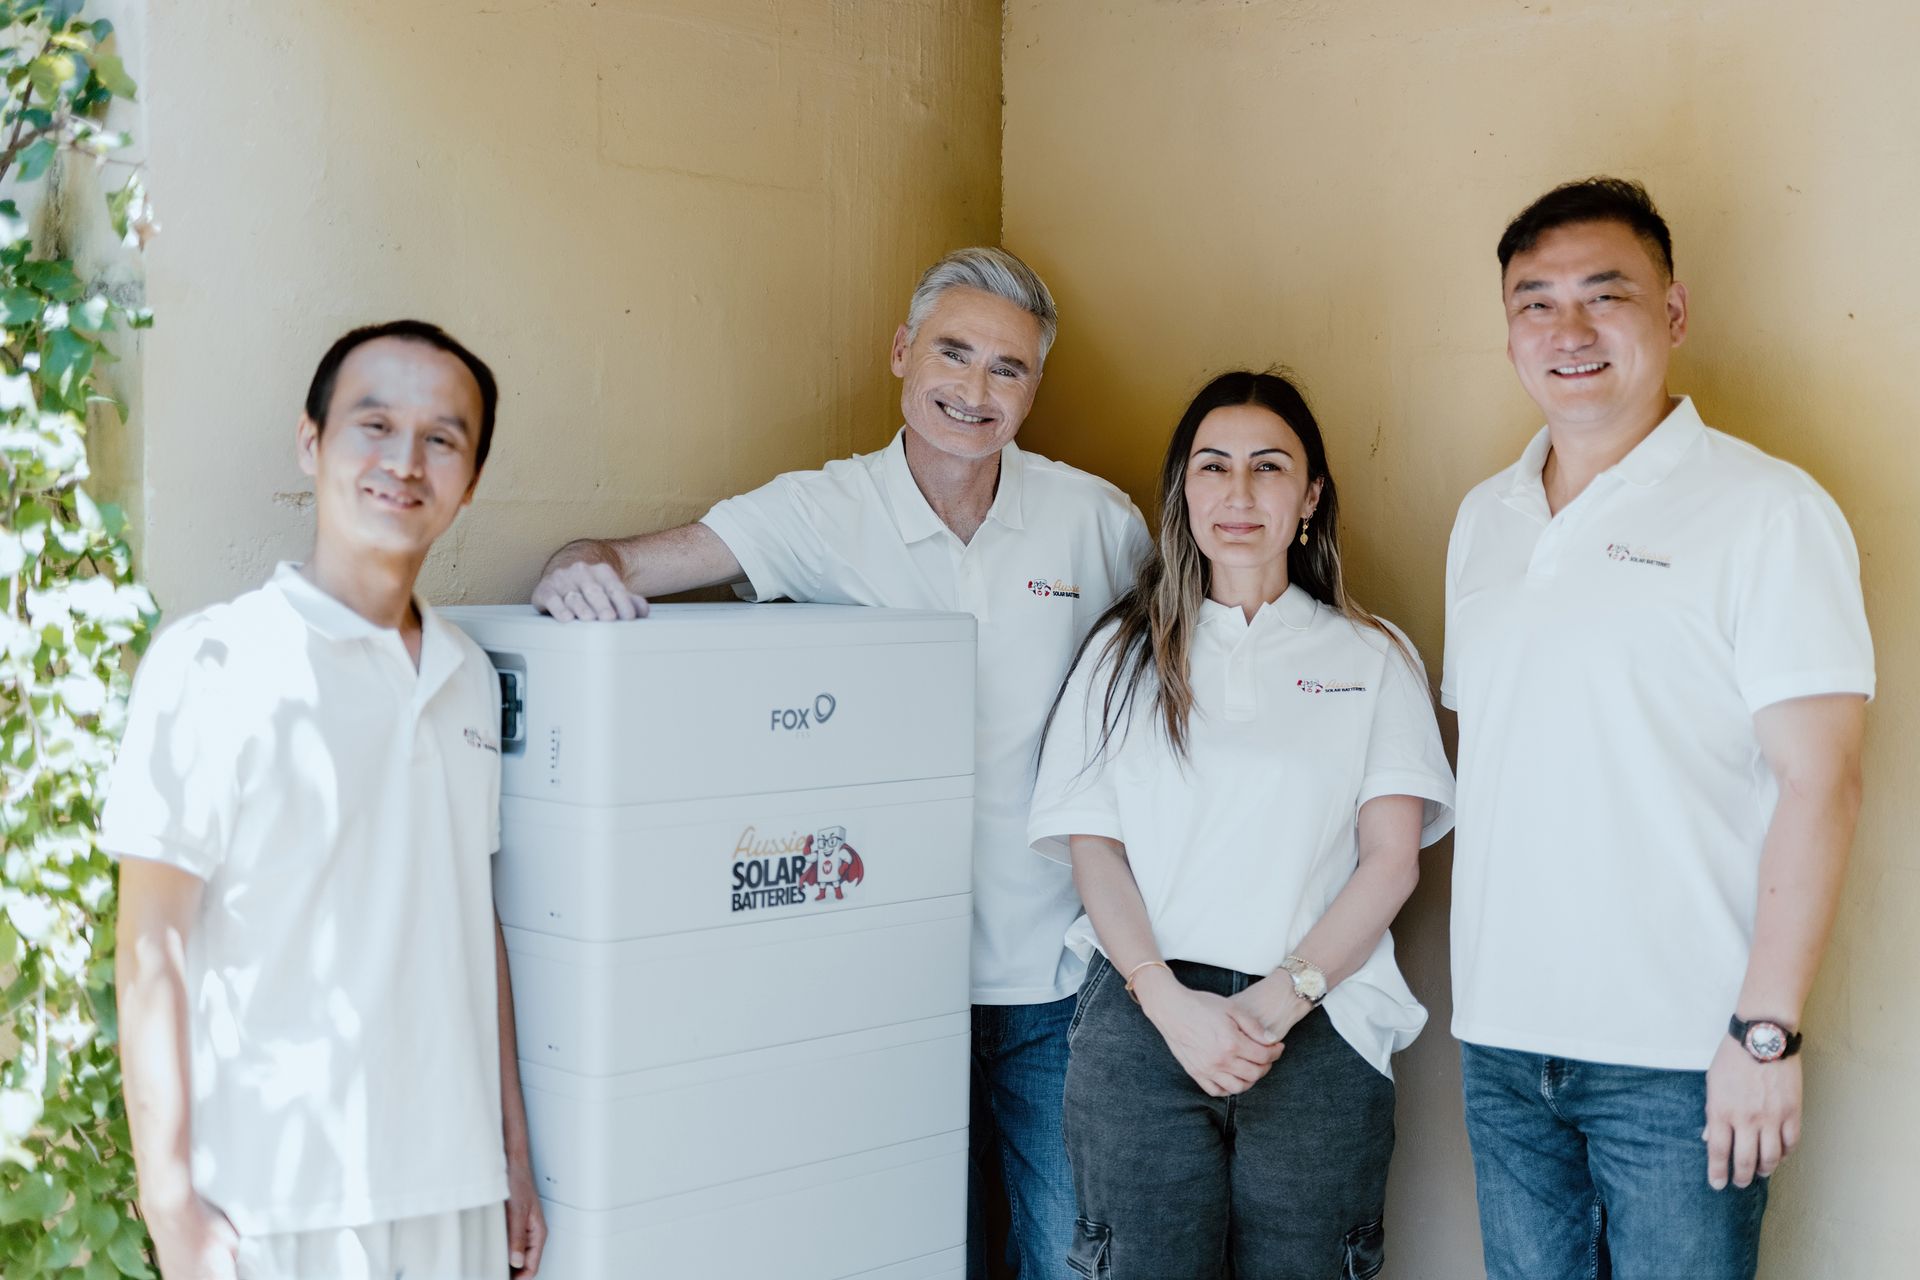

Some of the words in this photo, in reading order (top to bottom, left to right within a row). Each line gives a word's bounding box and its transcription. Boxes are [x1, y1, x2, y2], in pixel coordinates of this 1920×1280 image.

[771, 708, 810, 731] FOX
[732, 825, 806, 859] Aussie
[732, 855, 806, 891] SOLAR
[732, 884, 806, 912] BATTERIES
